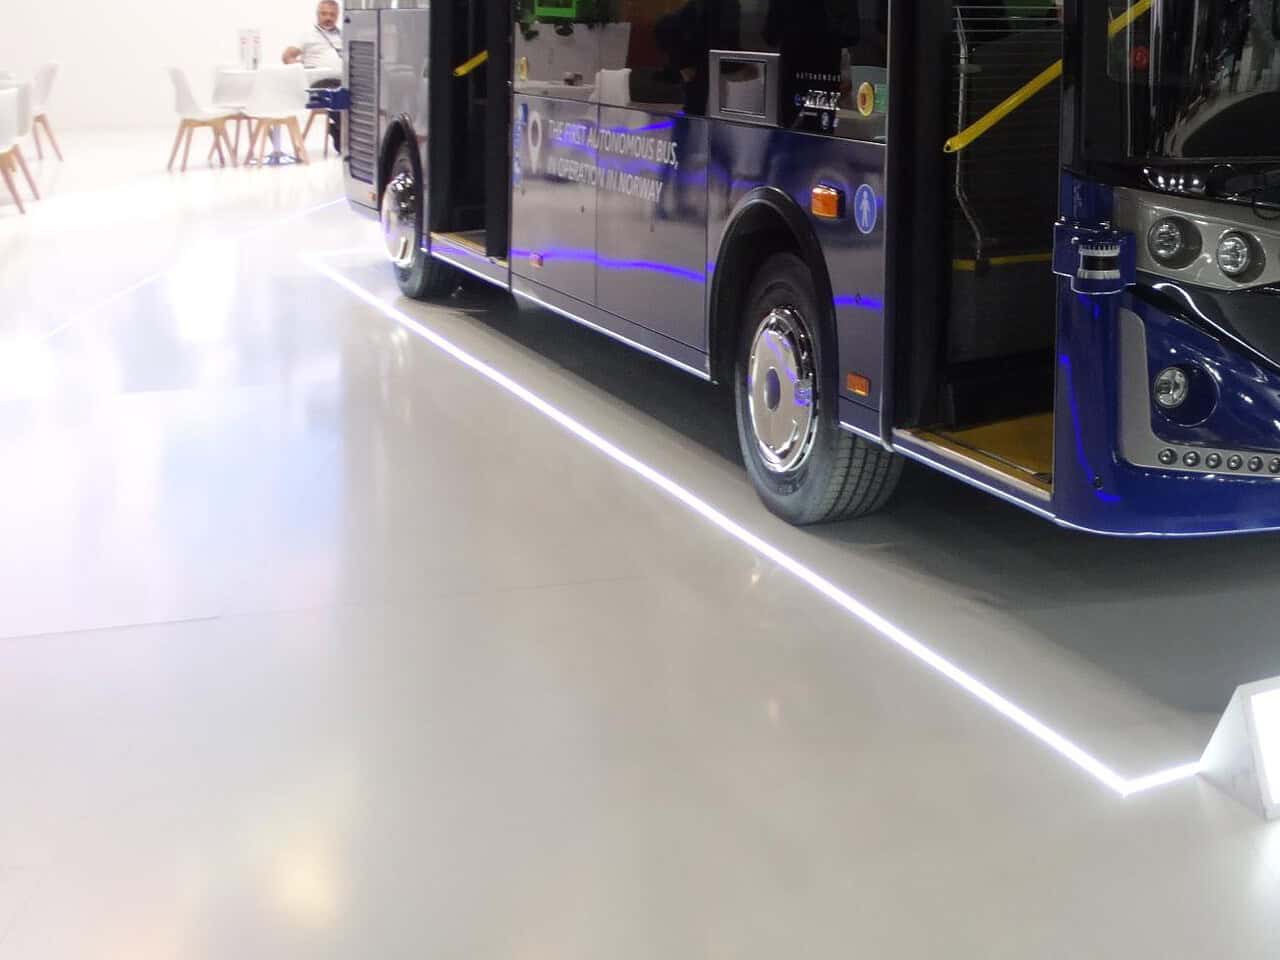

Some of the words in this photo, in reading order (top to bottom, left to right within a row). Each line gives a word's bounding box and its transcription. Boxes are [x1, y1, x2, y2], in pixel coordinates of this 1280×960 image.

[586, 127, 655, 161] AUTONOMOUS
[558, 158, 605, 187] OPERATION
[618, 172, 663, 203] NORWAY
